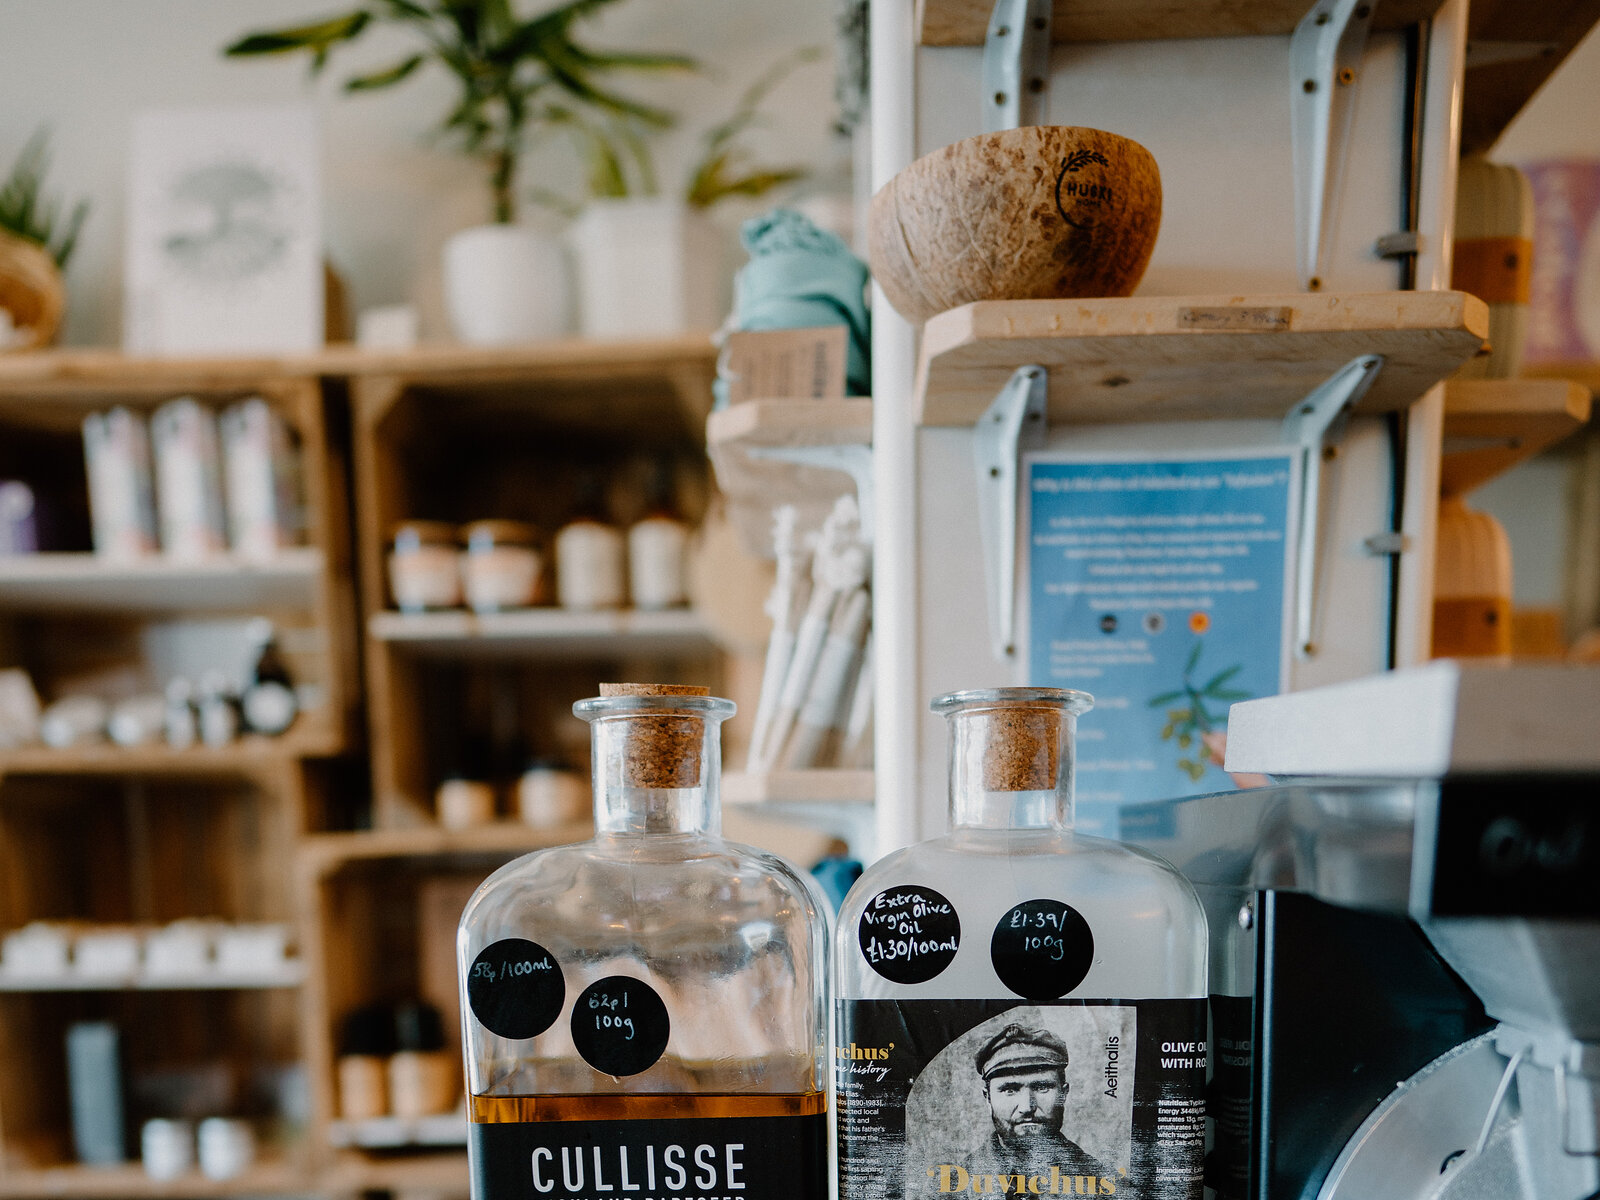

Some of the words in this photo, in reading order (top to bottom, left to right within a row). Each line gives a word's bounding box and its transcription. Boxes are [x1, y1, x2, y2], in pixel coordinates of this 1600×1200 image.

[874, 892, 927, 909] Extra
[864, 909, 910, 930] Virgin
[911, 901, 951, 917] Olive
[899, 919, 923, 934] Oil
[1025, 935, 1064, 960] 100g
[596, 1015, 635, 1040] 100g
[1161, 1042, 1195, 1053] OLIVE
[850, 1060, 893, 1082] history
[1104, 1036, 1119, 1098] Aeithalis
[1160, 1058, 1193, 1068] WITH
[1158, 1107, 1179, 1115] Energy
[531, 1143, 746, 1193] CULLISSE
